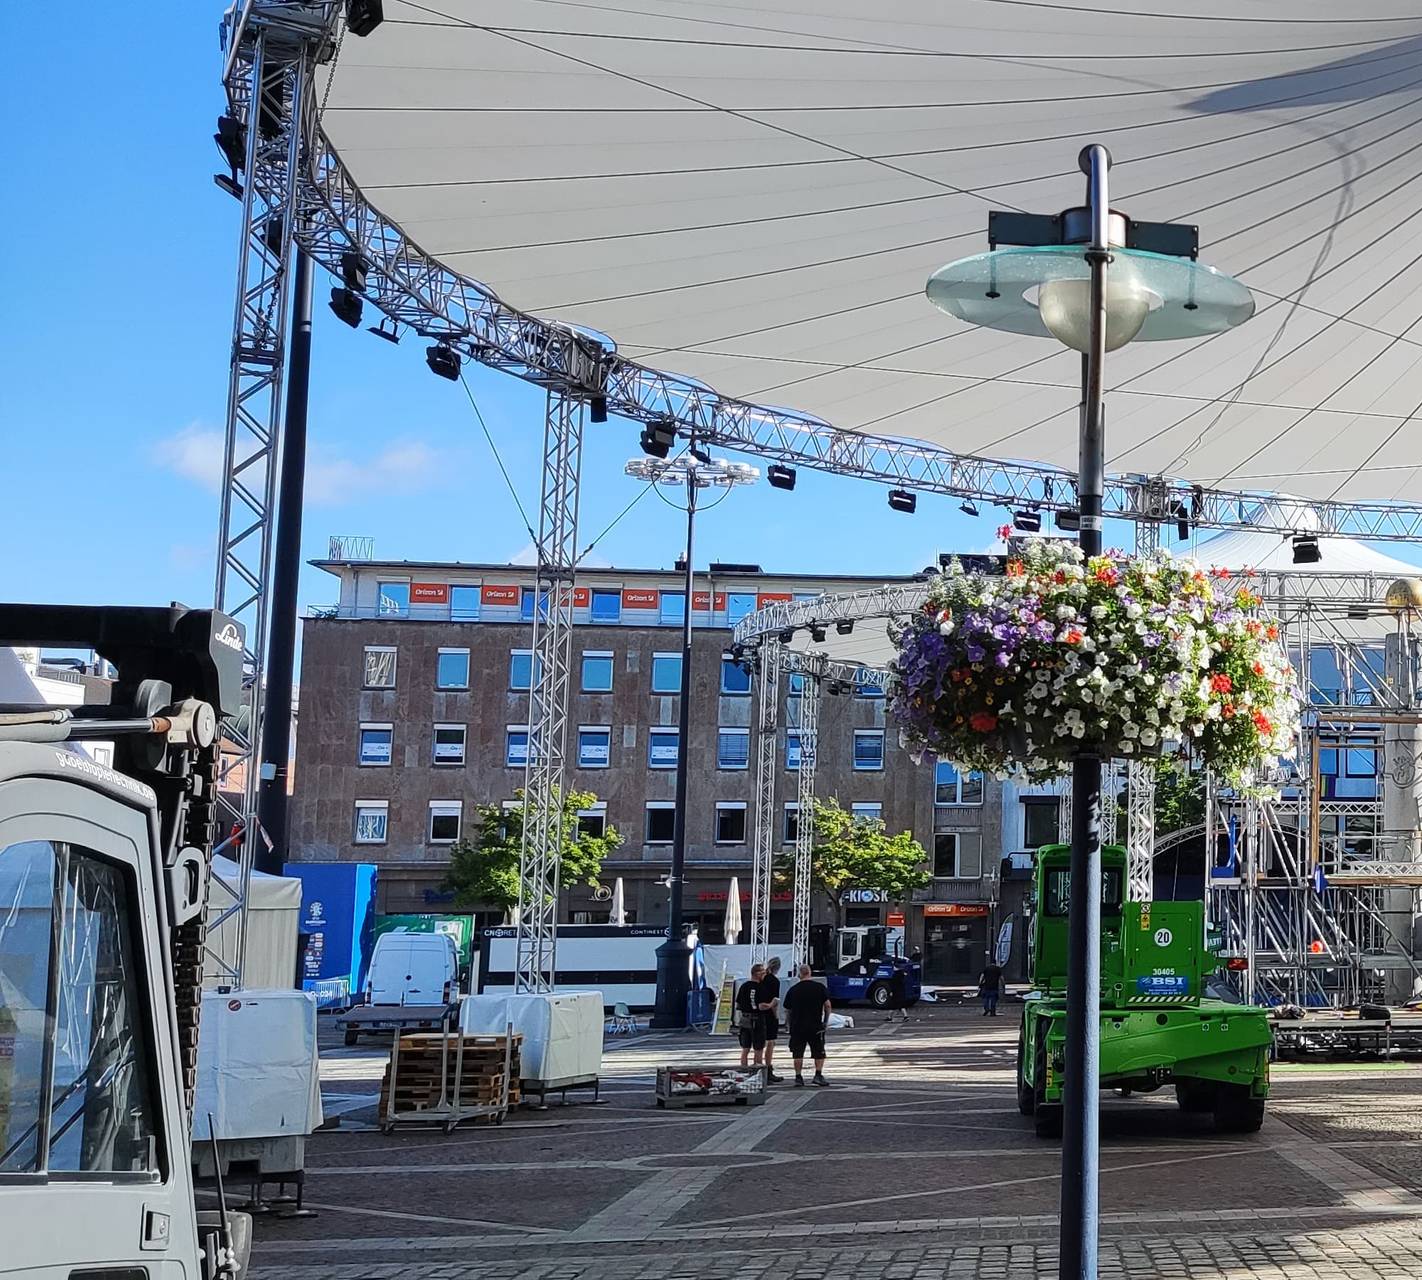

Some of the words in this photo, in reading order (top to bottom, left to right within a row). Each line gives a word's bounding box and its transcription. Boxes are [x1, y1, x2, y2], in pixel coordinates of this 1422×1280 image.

[215, 623, 243, 652] Linde
[1157, 932, 1170, 943] 20
[1152, 968, 1175, 976] 30405
[1151, 977, 1184, 985] BSI
